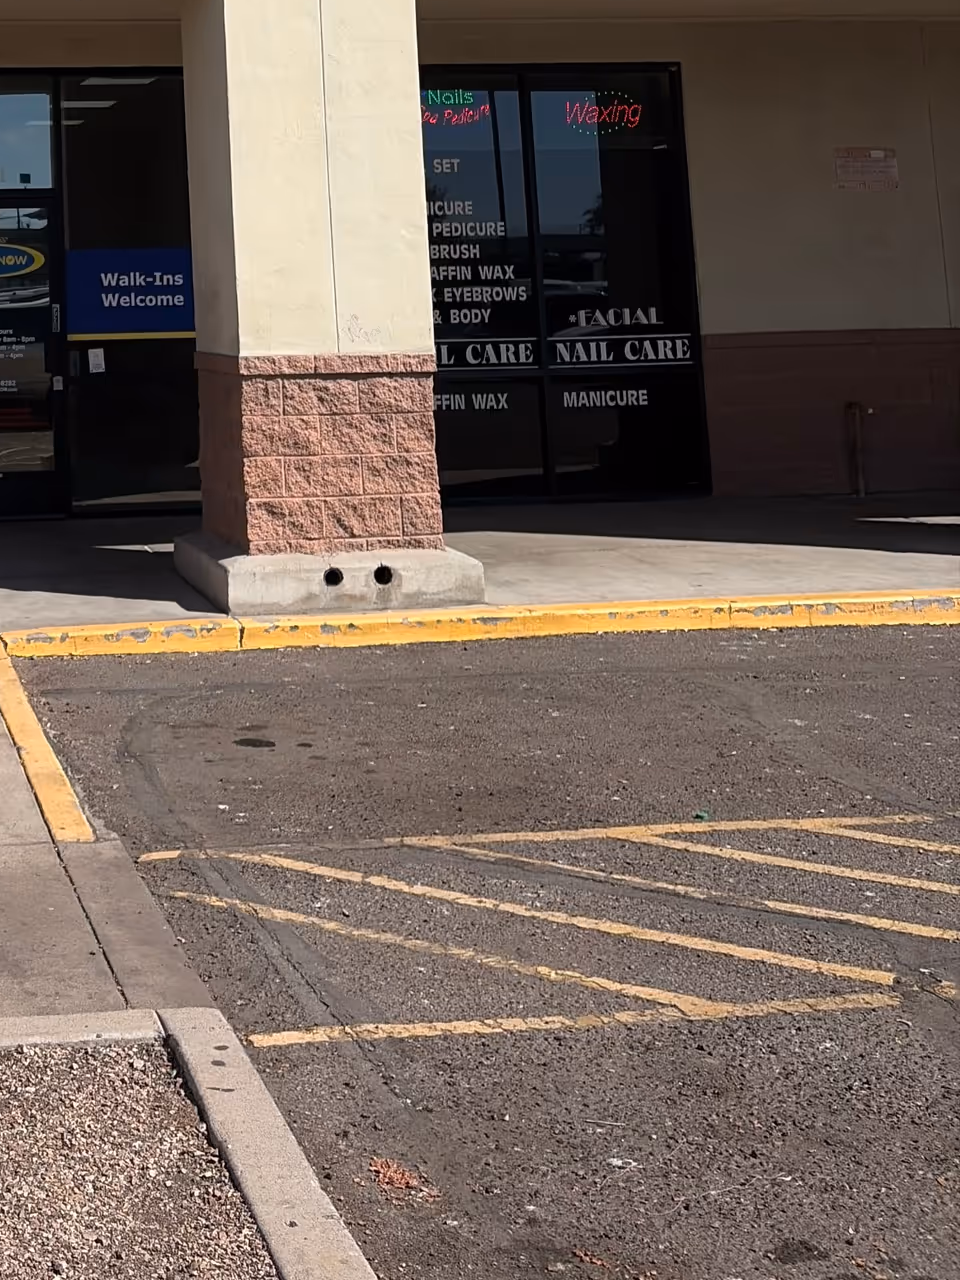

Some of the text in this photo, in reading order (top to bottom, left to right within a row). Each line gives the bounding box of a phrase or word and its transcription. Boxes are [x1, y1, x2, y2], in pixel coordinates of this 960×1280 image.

[428, 89, 474, 105] Nails
[565, 100, 642, 128] Waxing
[433, 159, 460, 174] SET
[432, 222, 505, 237] PEDICURE
[101, 272, 183, 286] Walk-Ins
[478, 265, 515, 280] WAX
[101, 292, 185, 307] Welcome
[444, 286, 527, 303] EYEBROWS
[450, 309, 491, 324] BODY
[465, 343, 534, 364] CARE
[555, 339, 690, 362] NAIL CARE
[472, 392, 509, 410] WAX
[563, 389, 648, 407] MANICURE
